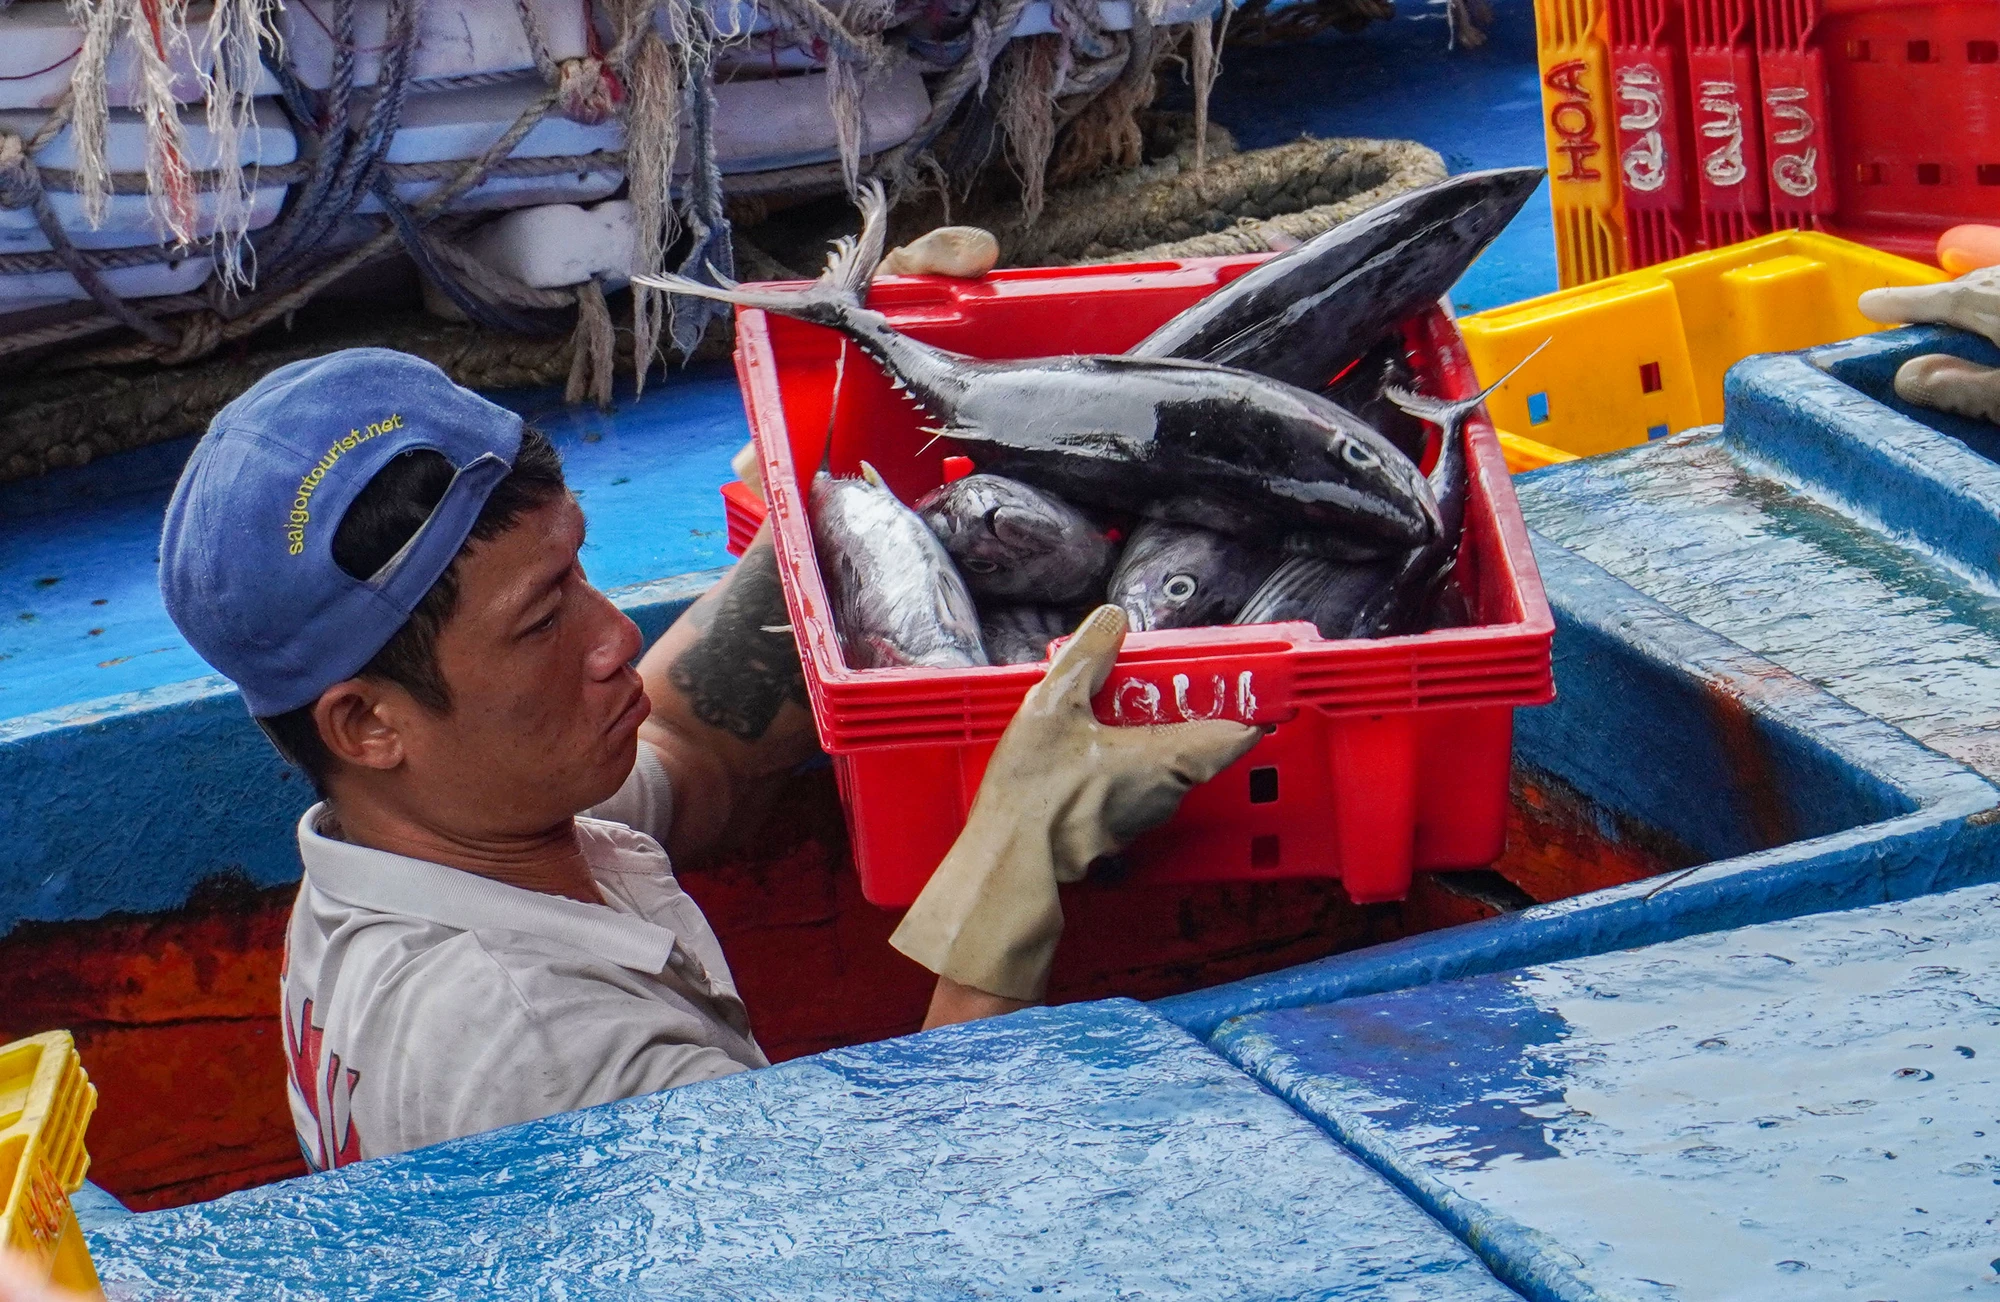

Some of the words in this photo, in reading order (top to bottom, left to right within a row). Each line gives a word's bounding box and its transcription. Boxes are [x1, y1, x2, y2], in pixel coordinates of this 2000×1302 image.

[1544, 59, 1601, 183] HOA
[1766, 86, 1818, 197] QUI
[283, 413, 404, 556] saigontourist.net
